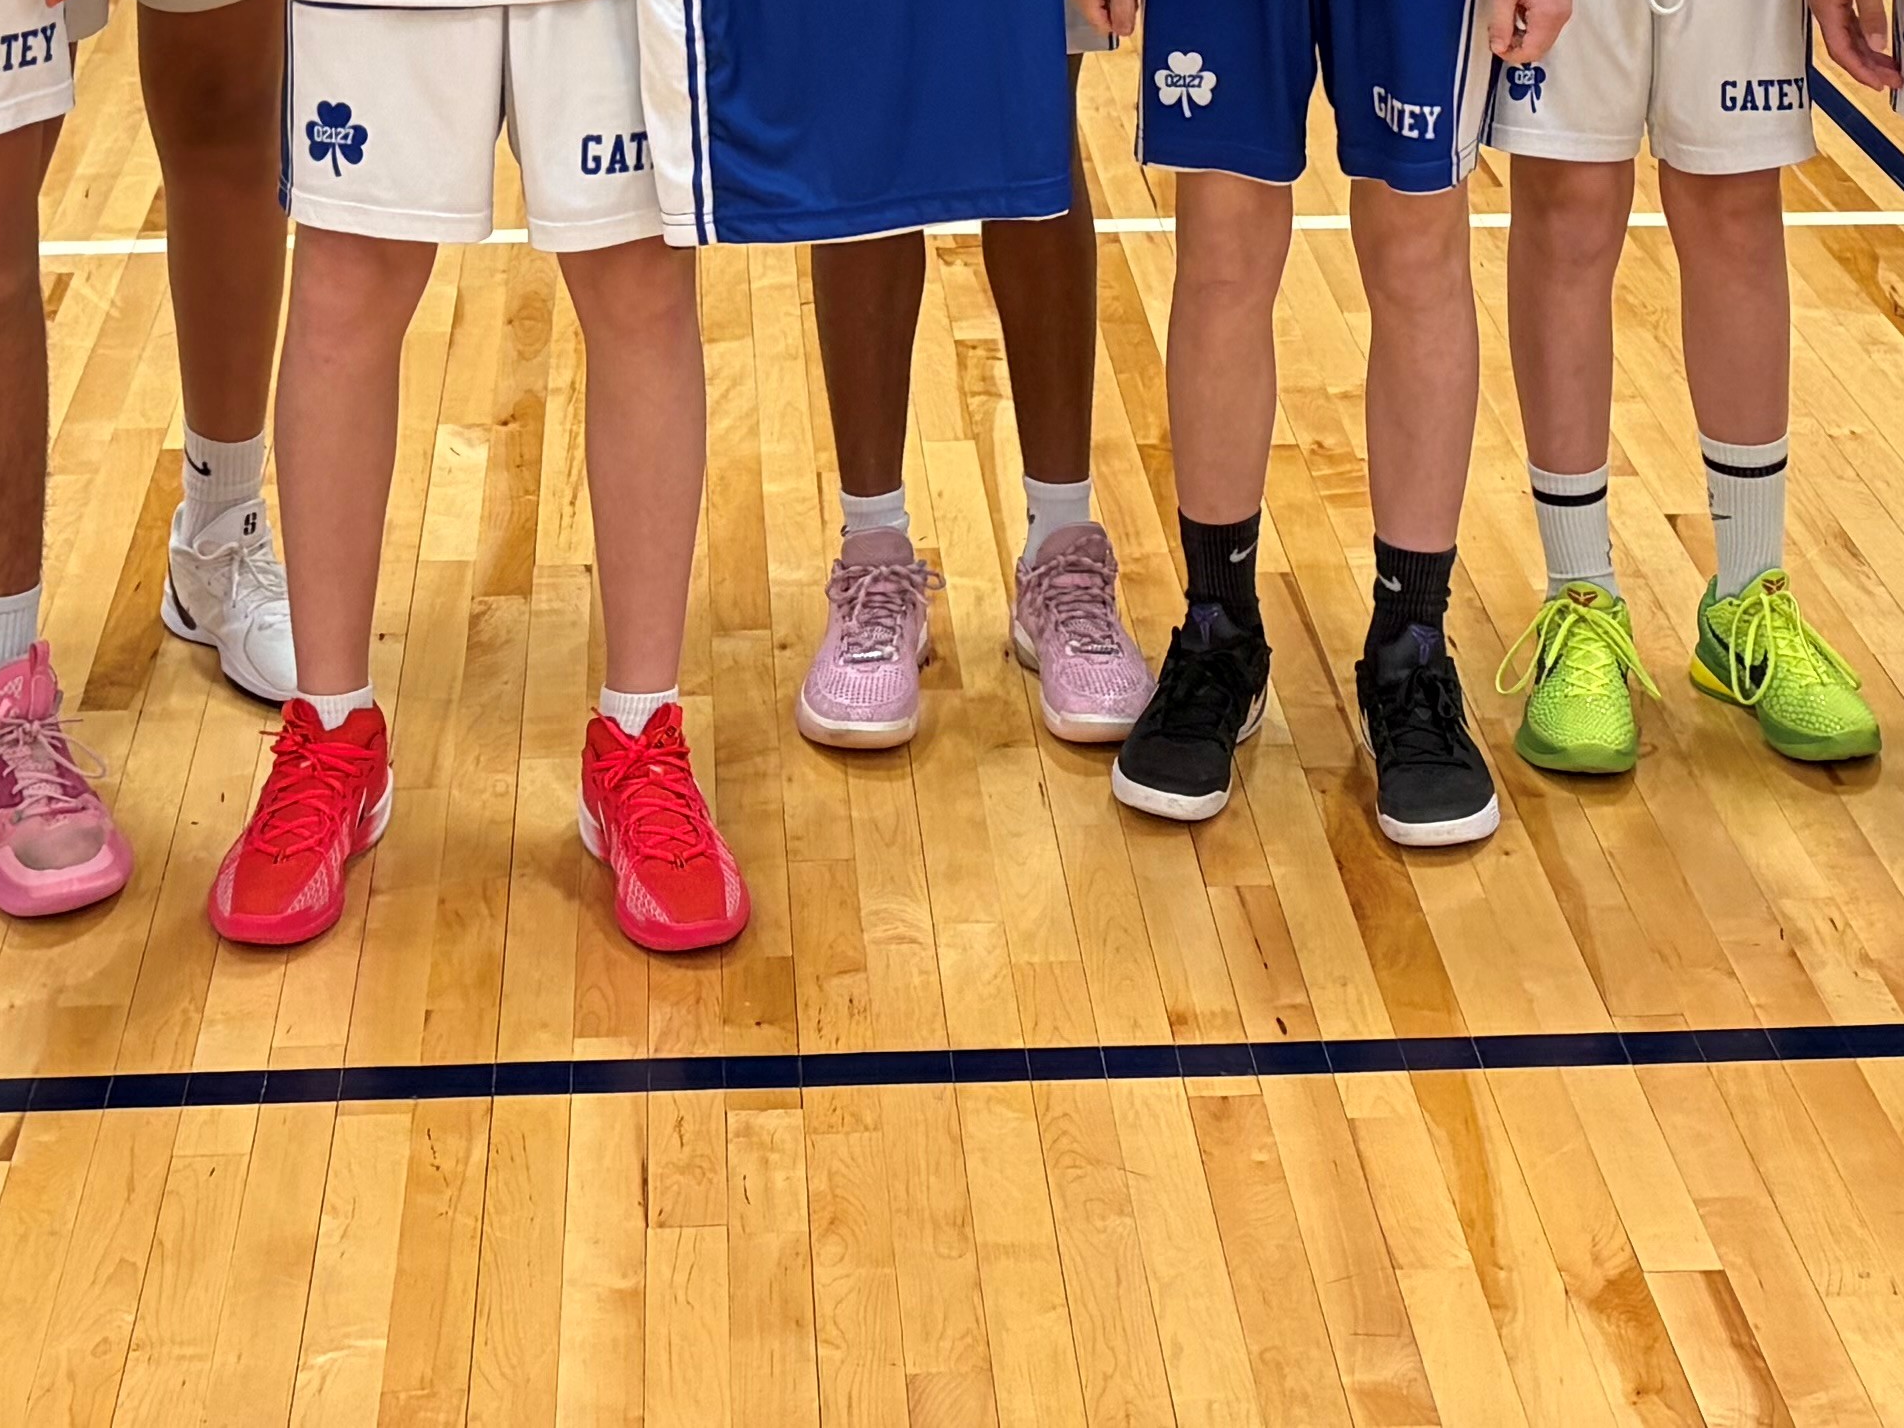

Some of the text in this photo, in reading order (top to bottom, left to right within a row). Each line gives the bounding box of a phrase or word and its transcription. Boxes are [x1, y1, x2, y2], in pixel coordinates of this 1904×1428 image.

[1164, 74, 1203, 89] 02127
[1721, 77, 1804, 111] GATEY
[314, 125, 354, 144] 02127
[581, 131, 653, 175] GAT
